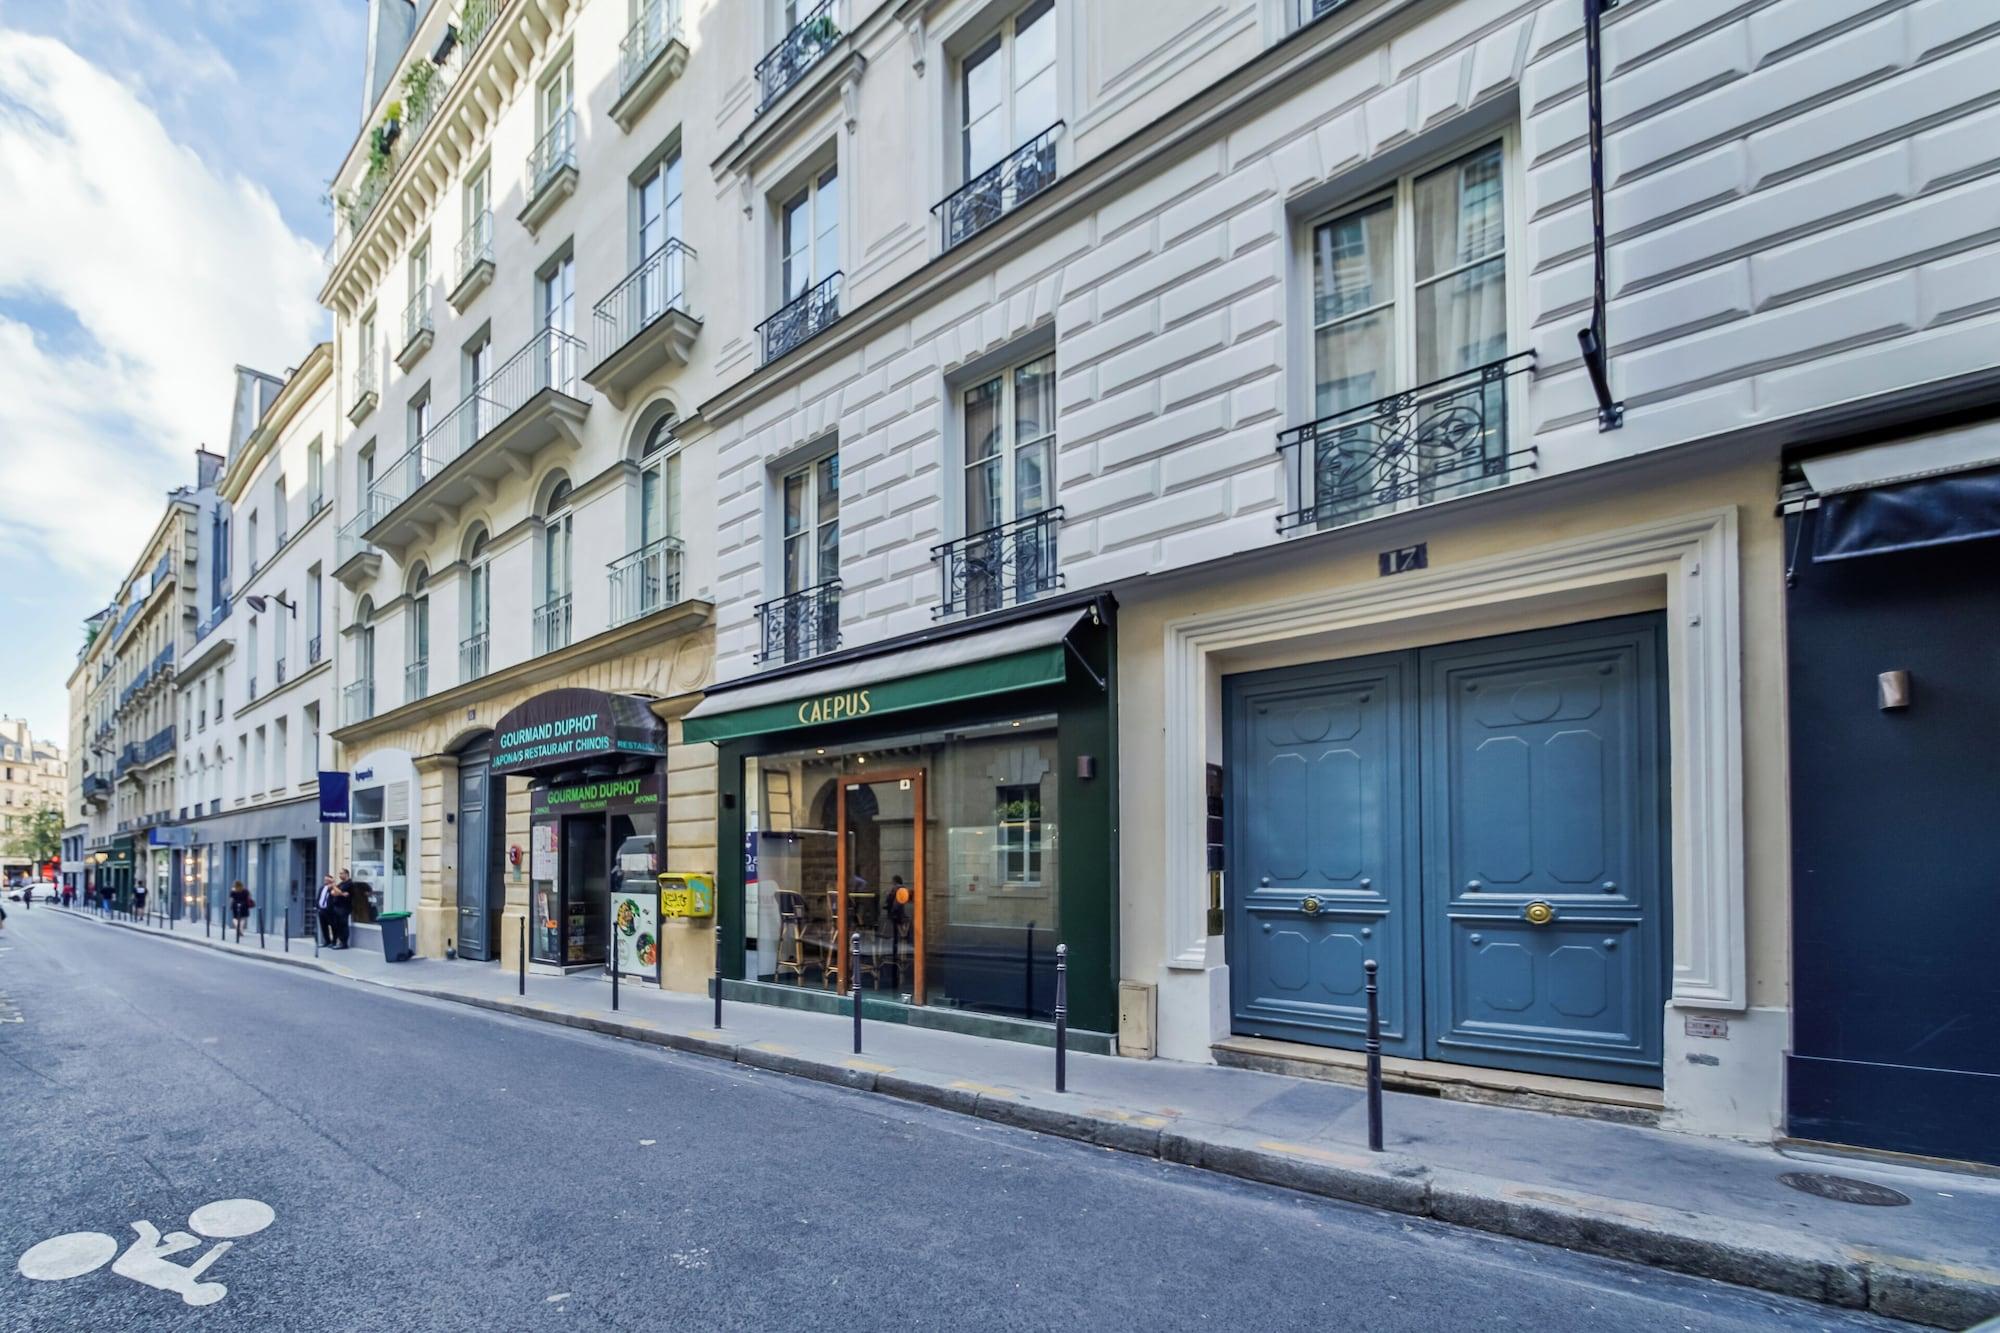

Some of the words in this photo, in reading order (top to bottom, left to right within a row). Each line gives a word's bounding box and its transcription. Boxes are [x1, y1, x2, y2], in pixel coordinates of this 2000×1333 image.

[1389, 546, 1417, 573] 17
[798, 690, 870, 724] CAEPUS
[500, 722, 552, 749] GOURMAND
[554, 714, 598, 737] DUPHOT
[524, 740, 574, 760] RESTAURANT
[575, 736, 610, 752] CHINOIS
[547, 785, 598, 804] GOURMAND
[599, 778, 641, 798] DUPHOT
